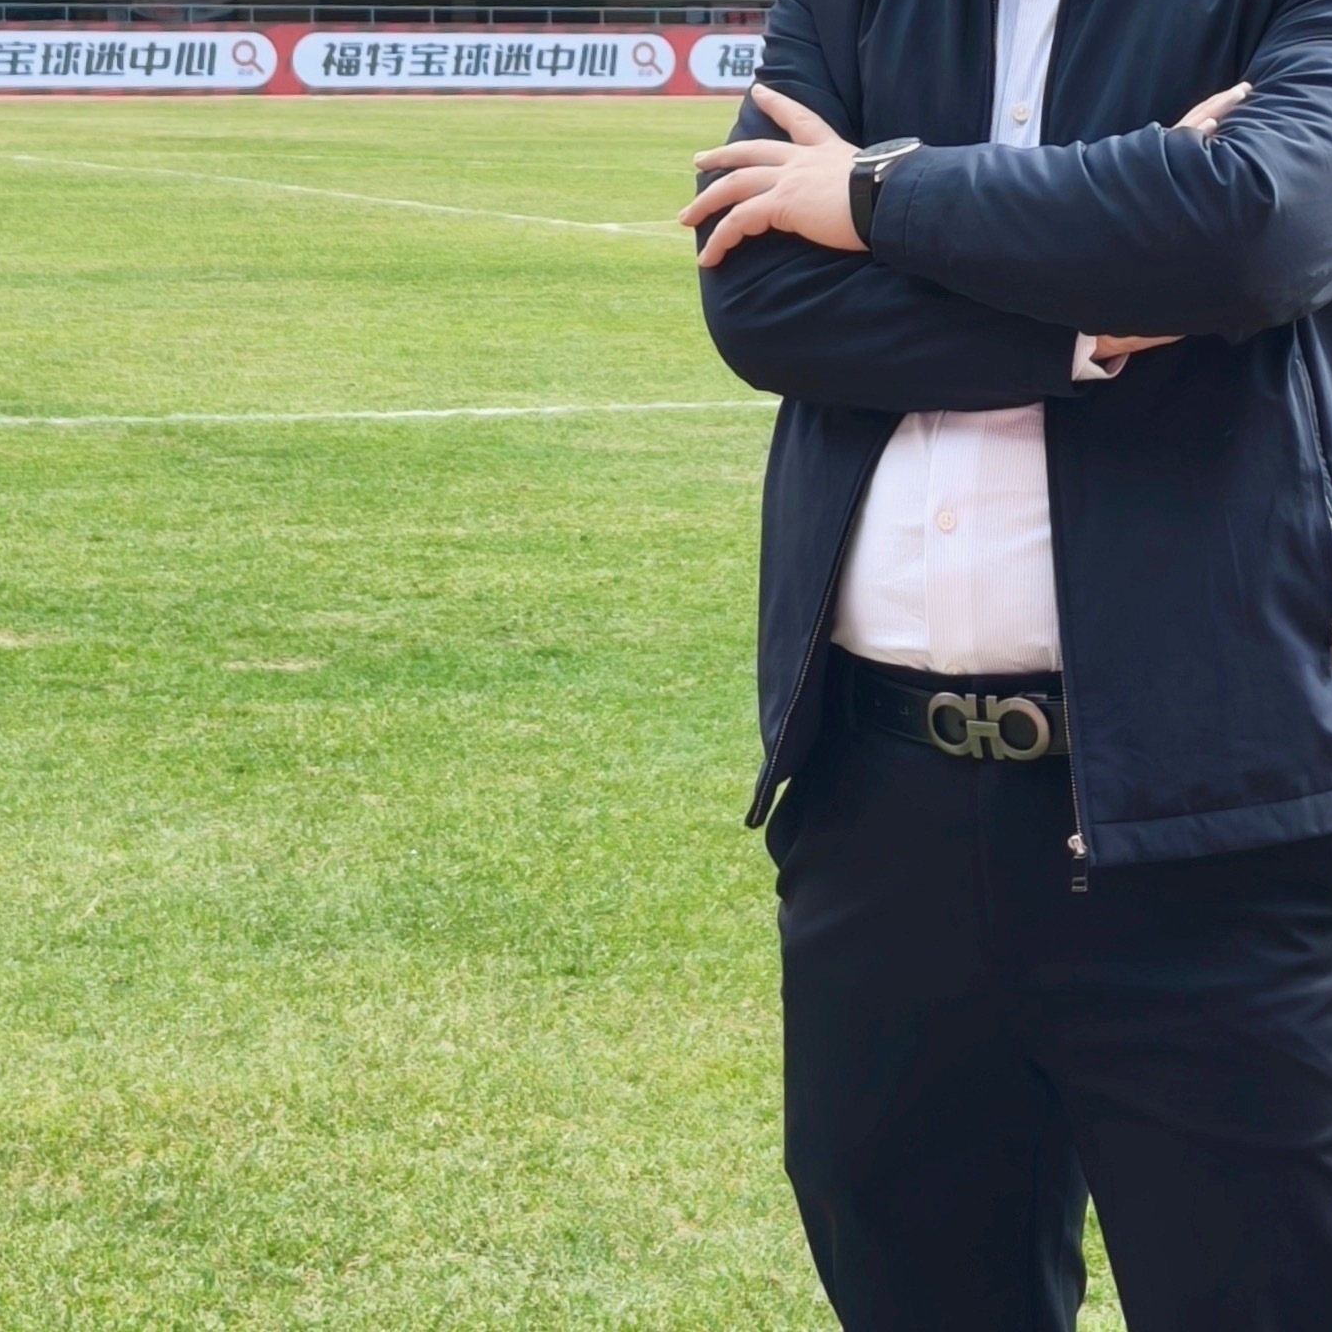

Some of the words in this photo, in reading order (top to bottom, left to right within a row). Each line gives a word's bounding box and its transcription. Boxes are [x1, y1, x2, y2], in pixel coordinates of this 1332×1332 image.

[321, 42, 618, 77] 福特宝球迷中心
